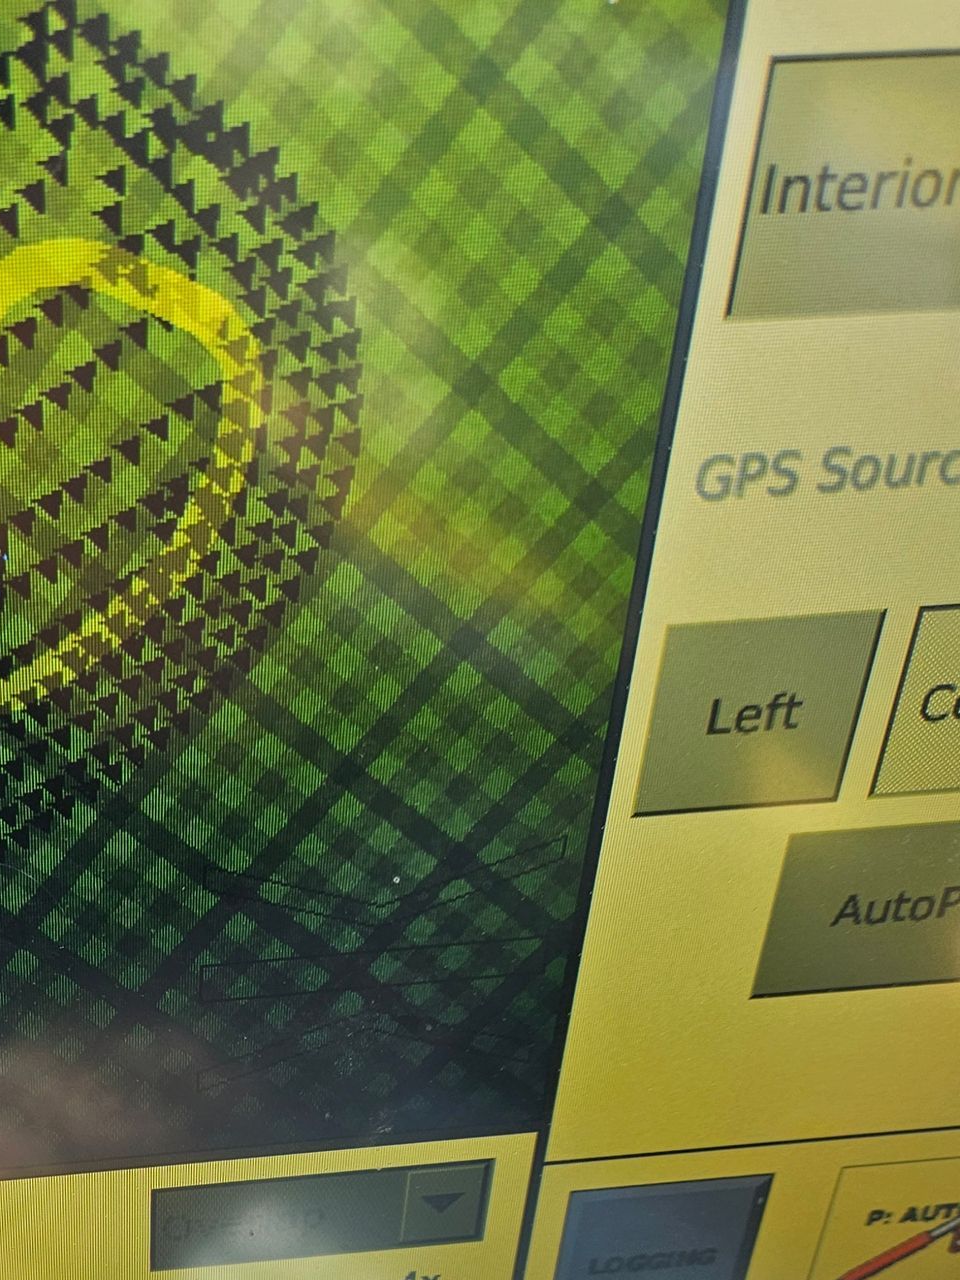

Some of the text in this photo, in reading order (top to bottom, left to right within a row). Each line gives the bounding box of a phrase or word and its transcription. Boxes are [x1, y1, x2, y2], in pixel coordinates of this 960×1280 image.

[759, 156, 960, 216] Interior
[695, 445, 960, 501] GPS Sourc
[706, 691, 804, 736] Left
[829, 885, 960, 928] AutoP
[587, 1247, 719, 1276] LOGGING
